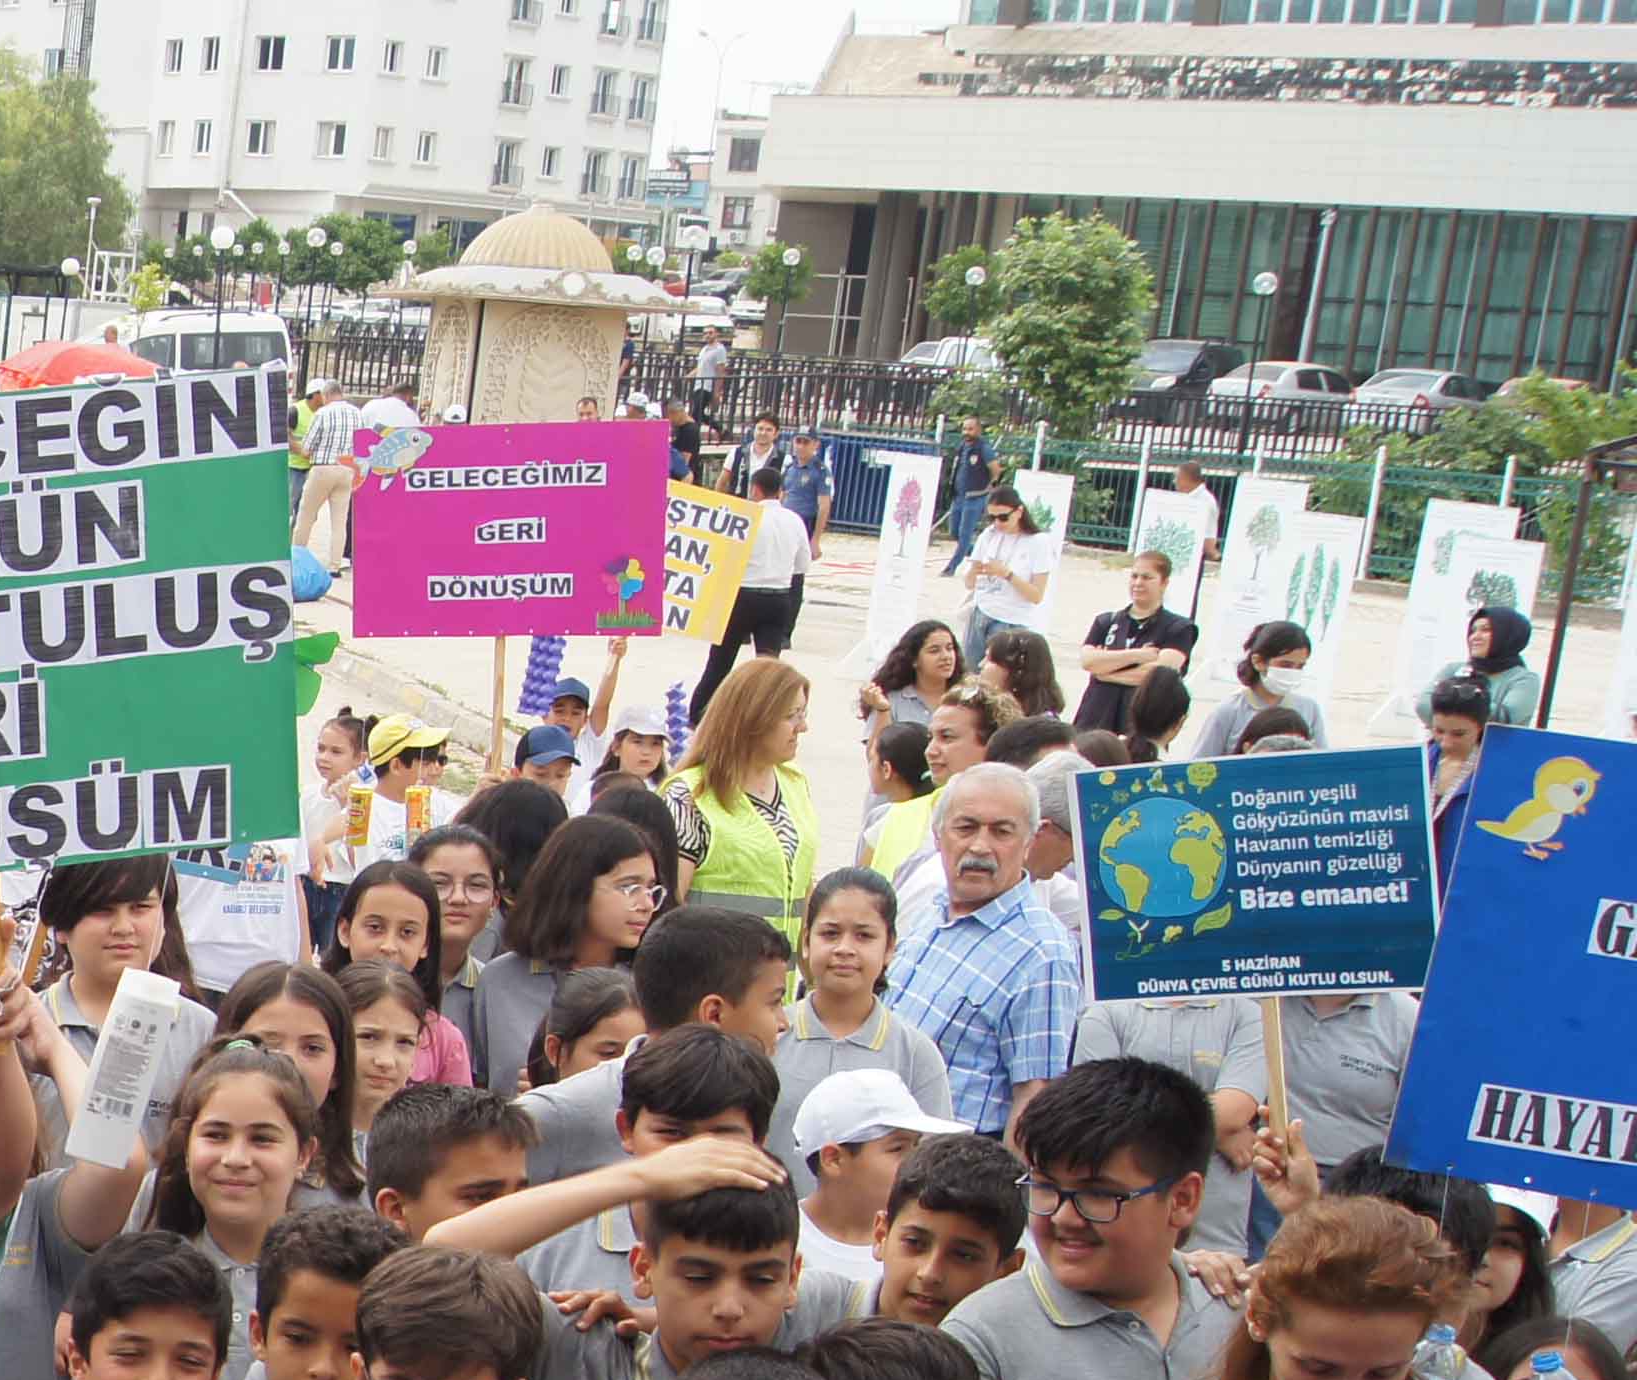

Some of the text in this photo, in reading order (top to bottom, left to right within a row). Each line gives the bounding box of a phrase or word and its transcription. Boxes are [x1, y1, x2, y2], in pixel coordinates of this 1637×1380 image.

[407, 461, 605, 490] GELECEĞİMİZ
[477, 517, 544, 542] GERİ
[666, 498, 750, 541] ŞTÜR
[429, 574, 572, 601] DÖNÜŞÜM
[1231, 784, 1357, 809] Doğanın yeşili
[1232, 804, 1409, 832] Gökyüzünün mavisi
[1235, 830, 1394, 854] Havanın temizliği
[1236, 853, 1402, 880] Dünyanın güzelliği
[1240, 881, 1409, 911] Bize emanet!
[1221, 955, 1301, 972] 5 HAZİRAN
[1137, 971, 1394, 994] DÜNYA ÇEVRE GÜNÜ KUTLU OLSUN.
